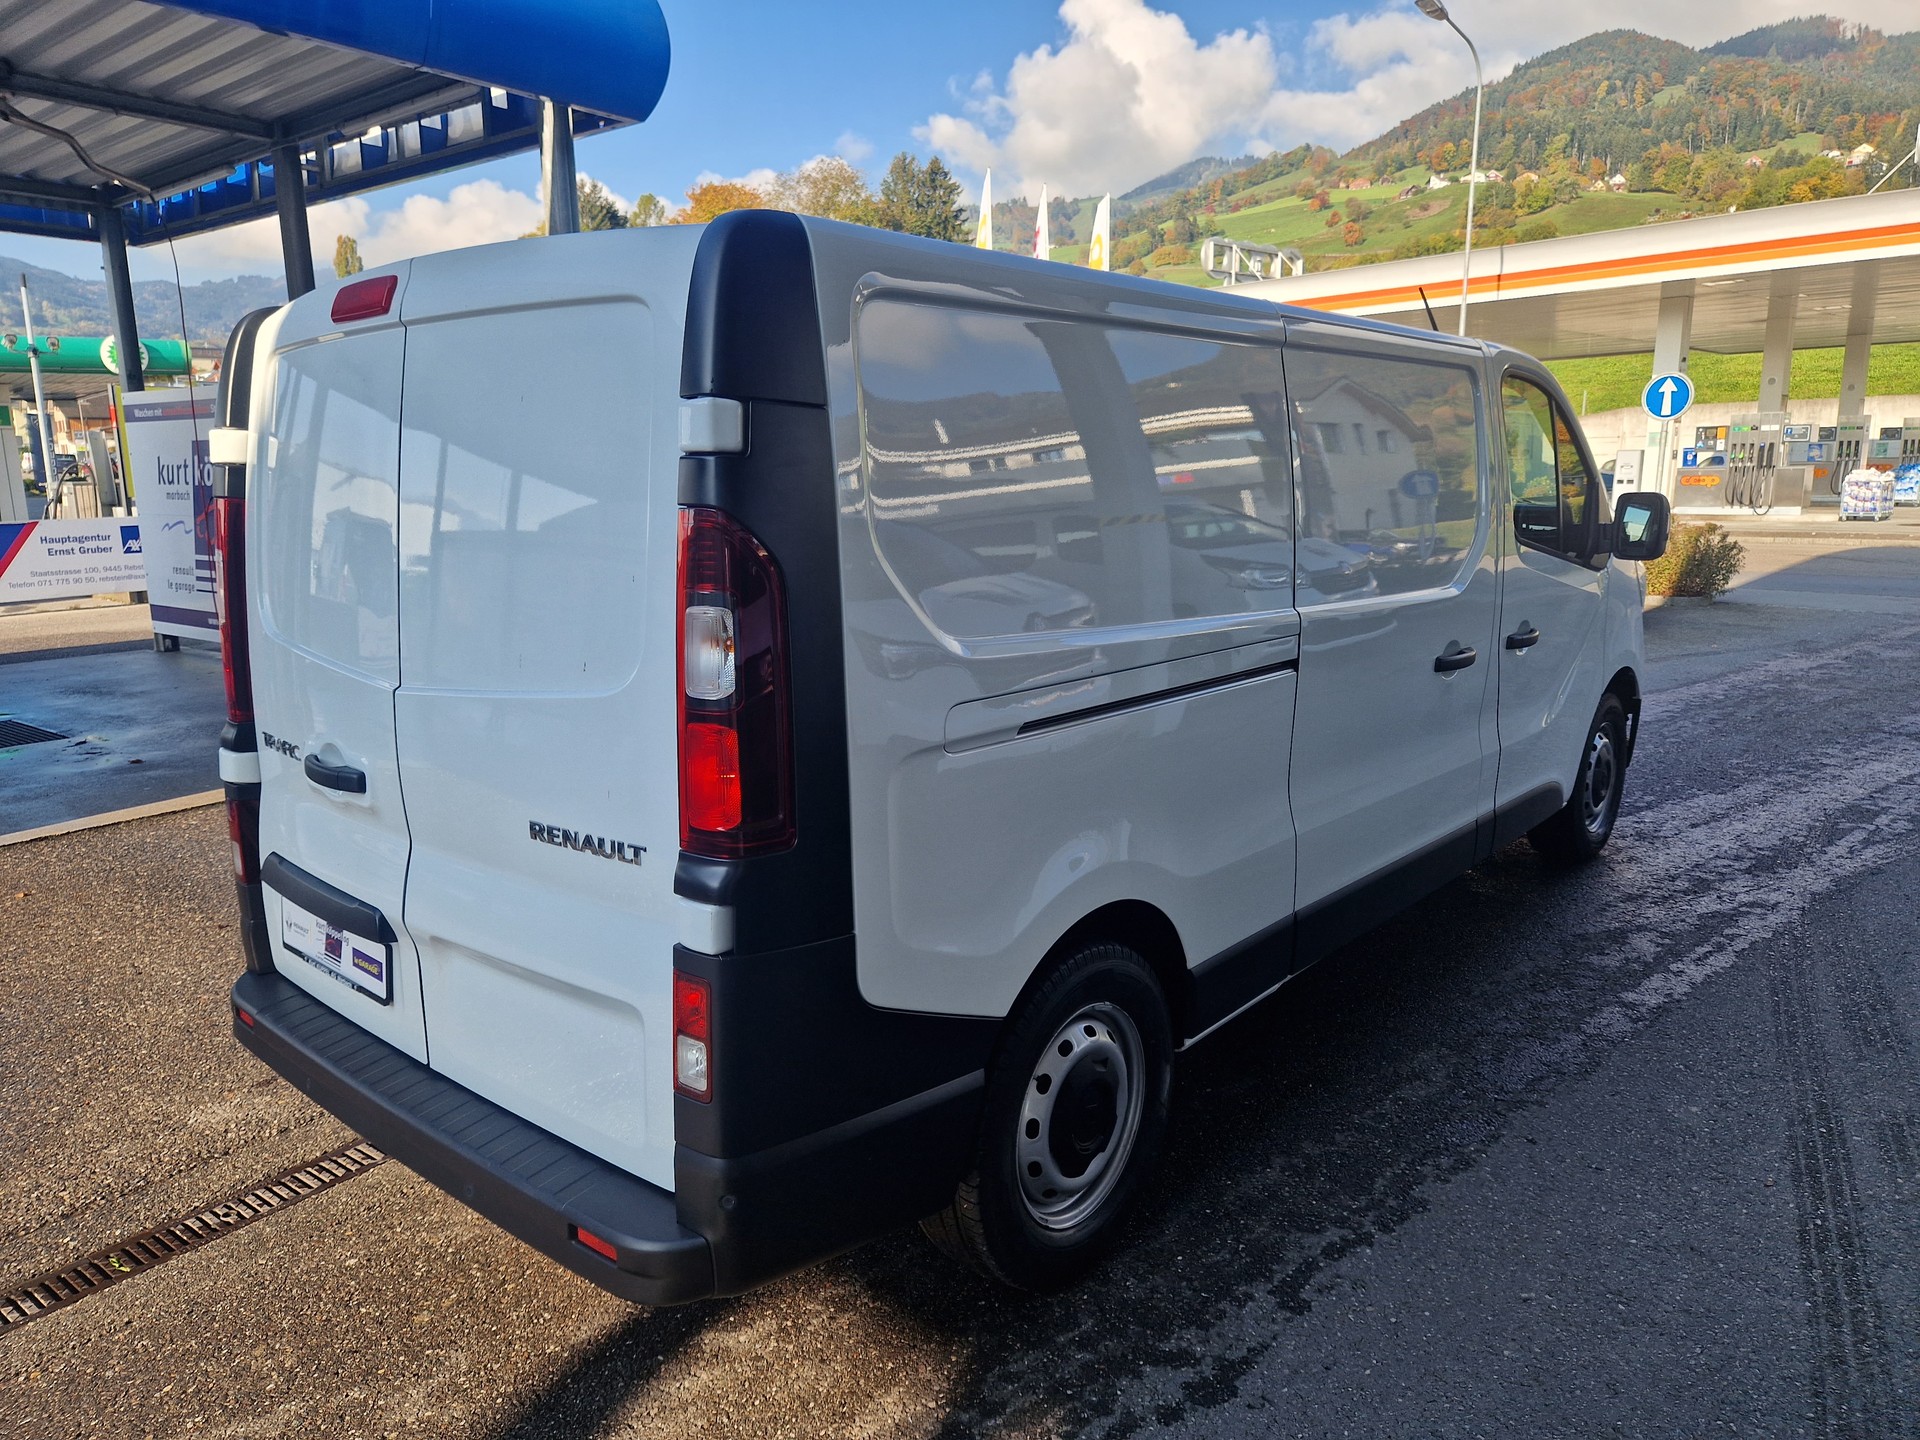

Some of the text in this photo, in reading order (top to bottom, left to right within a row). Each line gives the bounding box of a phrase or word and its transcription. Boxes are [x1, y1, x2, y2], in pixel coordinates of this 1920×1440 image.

[157, 456, 189, 485] kurt
[40, 534, 111, 545] Hauptagentur
[48, 545, 113, 557] Ernst Gruber
[30, 568, 82, 578] Staatsstrasse
[84, 566, 101, 575] 100,
[102, 564, 122, 573] 9445
[8, 580, 36, 589] Telefon
[37, 579, 53, 587] 071
[56, 577, 71, 586] 775
[72, 577, 83, 585] 90
[84, 576, 98, 584] 50,
[529, 820, 647, 866] RENAULT
